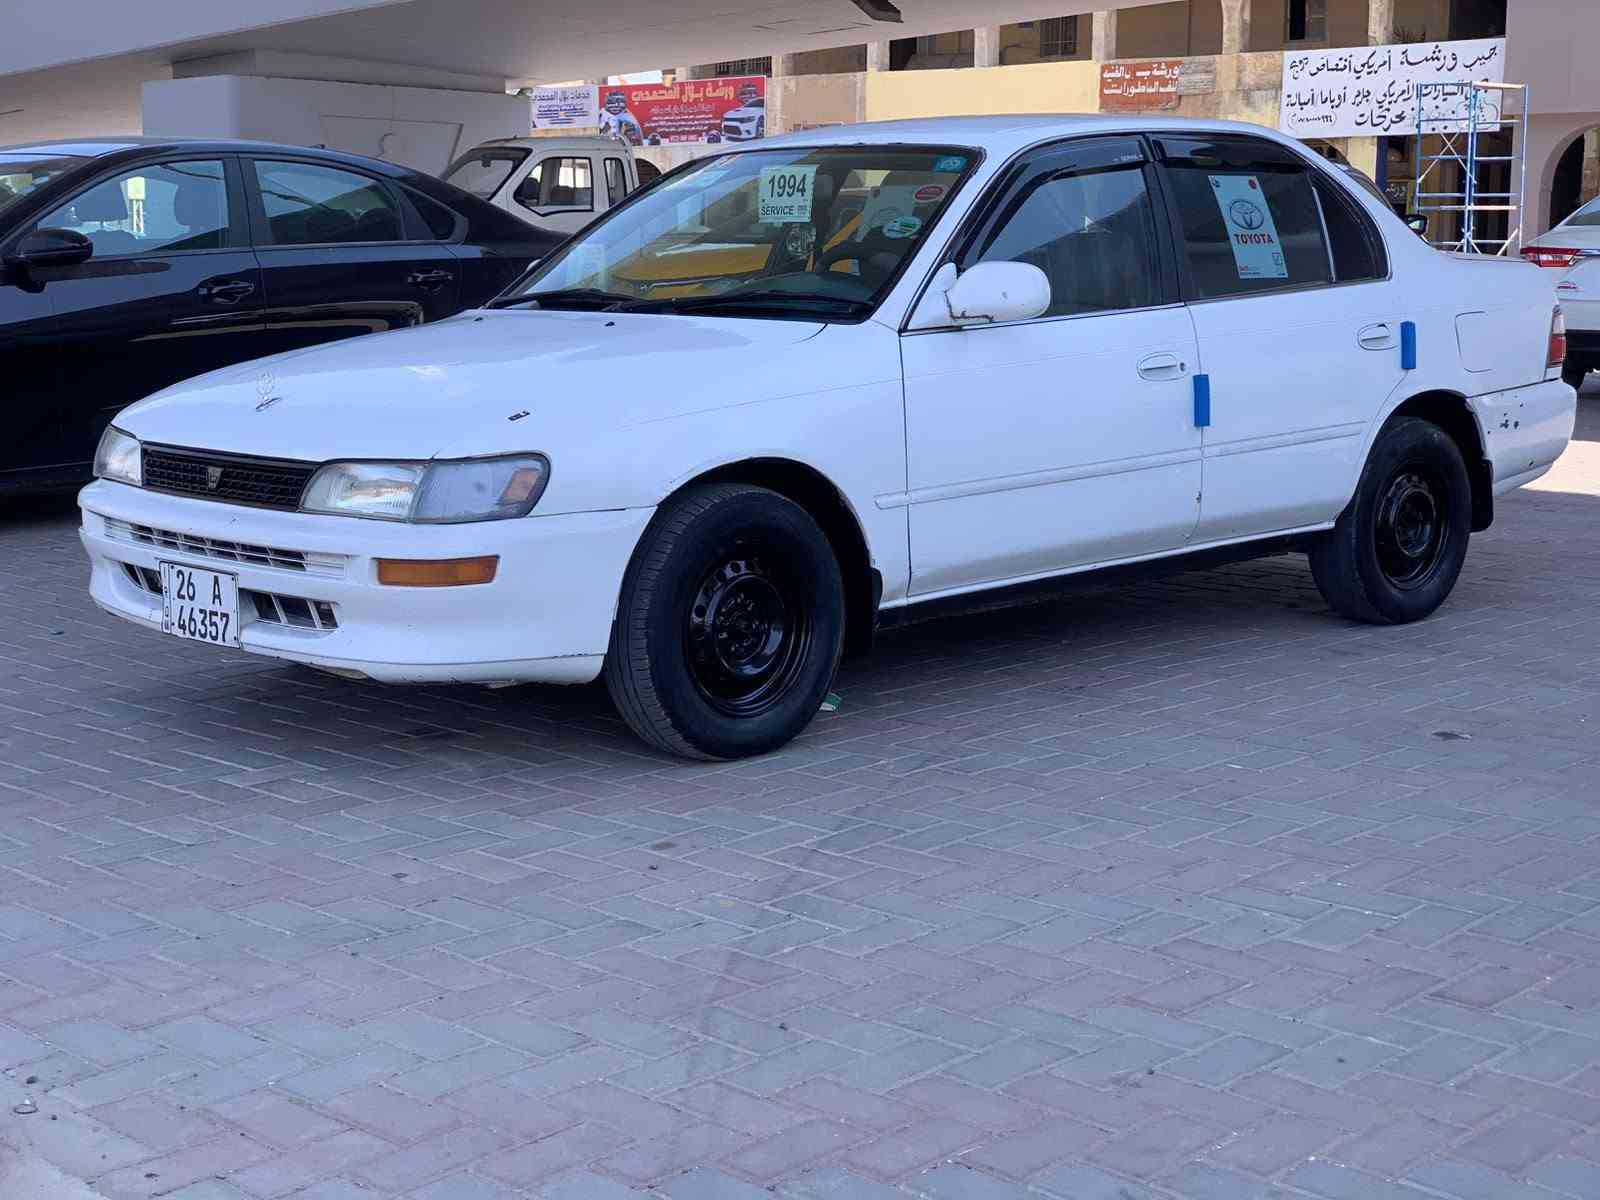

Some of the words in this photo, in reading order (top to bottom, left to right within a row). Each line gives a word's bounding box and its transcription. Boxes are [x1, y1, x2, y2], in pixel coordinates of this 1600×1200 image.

[1400, 44, 1458, 72] ورشة
[768, 173, 807, 198] 1994
[760, 204, 794, 216] SERVICE
[1233, 233, 1274, 245] TOYOTA
[176, 569, 196, 601] 26
[212, 575, 222, 606] A
[177, 605, 230, 642] 46357
